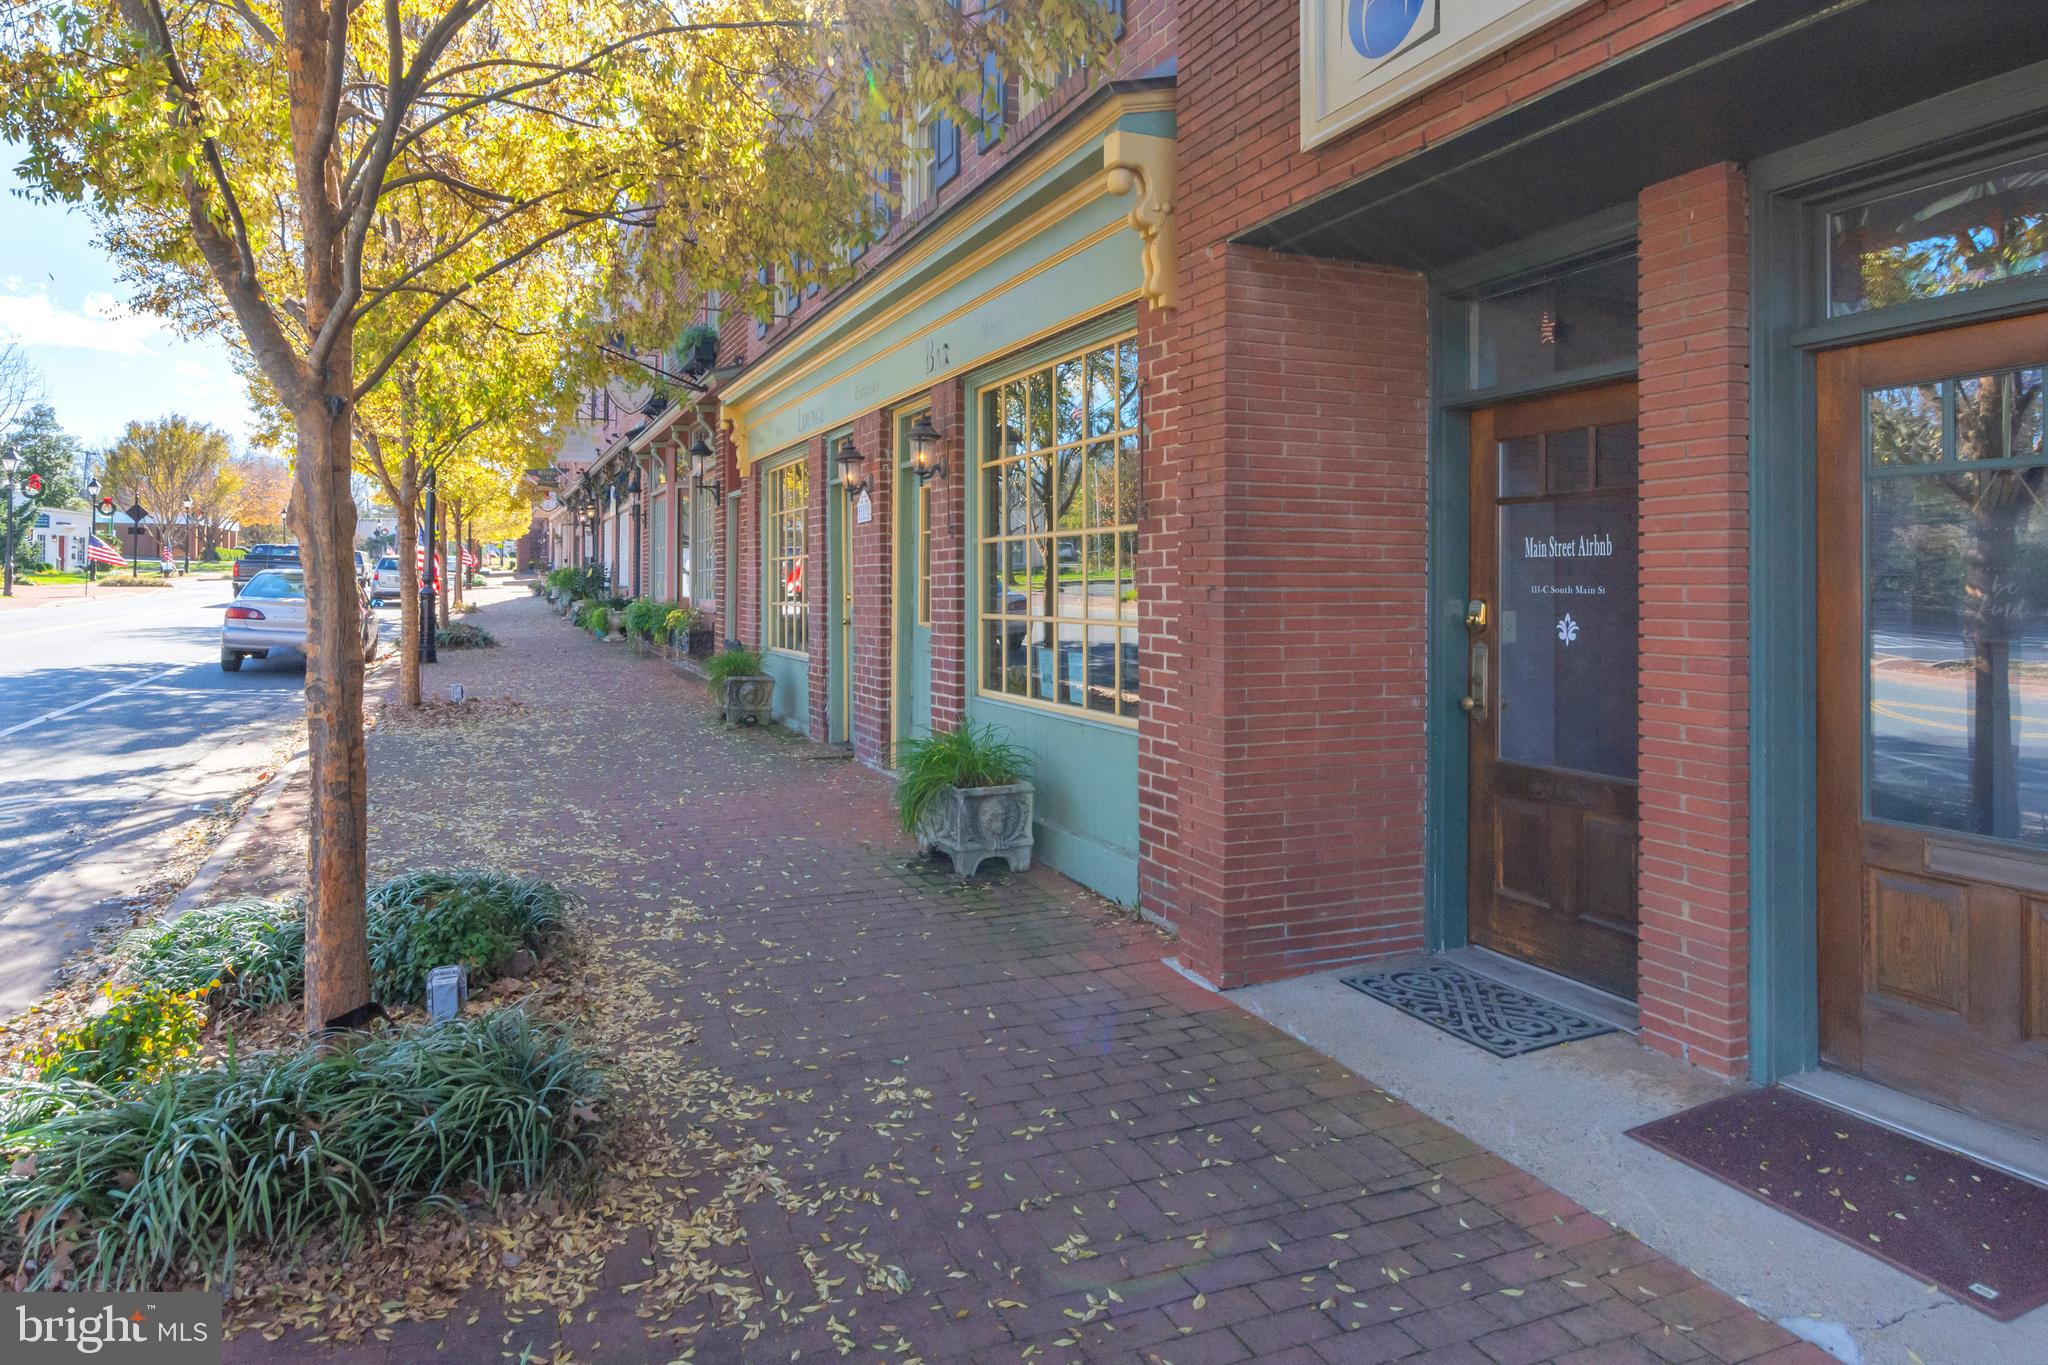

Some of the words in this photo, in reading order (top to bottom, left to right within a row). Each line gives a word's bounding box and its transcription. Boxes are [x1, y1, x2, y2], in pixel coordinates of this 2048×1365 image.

[1525, 537, 1547, 558] Main
[1549, 535, 1576, 557] Street
[1578, 533, 1613, 556] Airbnb
[1550, 585, 1573, 594] South
[1575, 585, 1596, 595] Main
[1597, 585, 1606, 594] St
